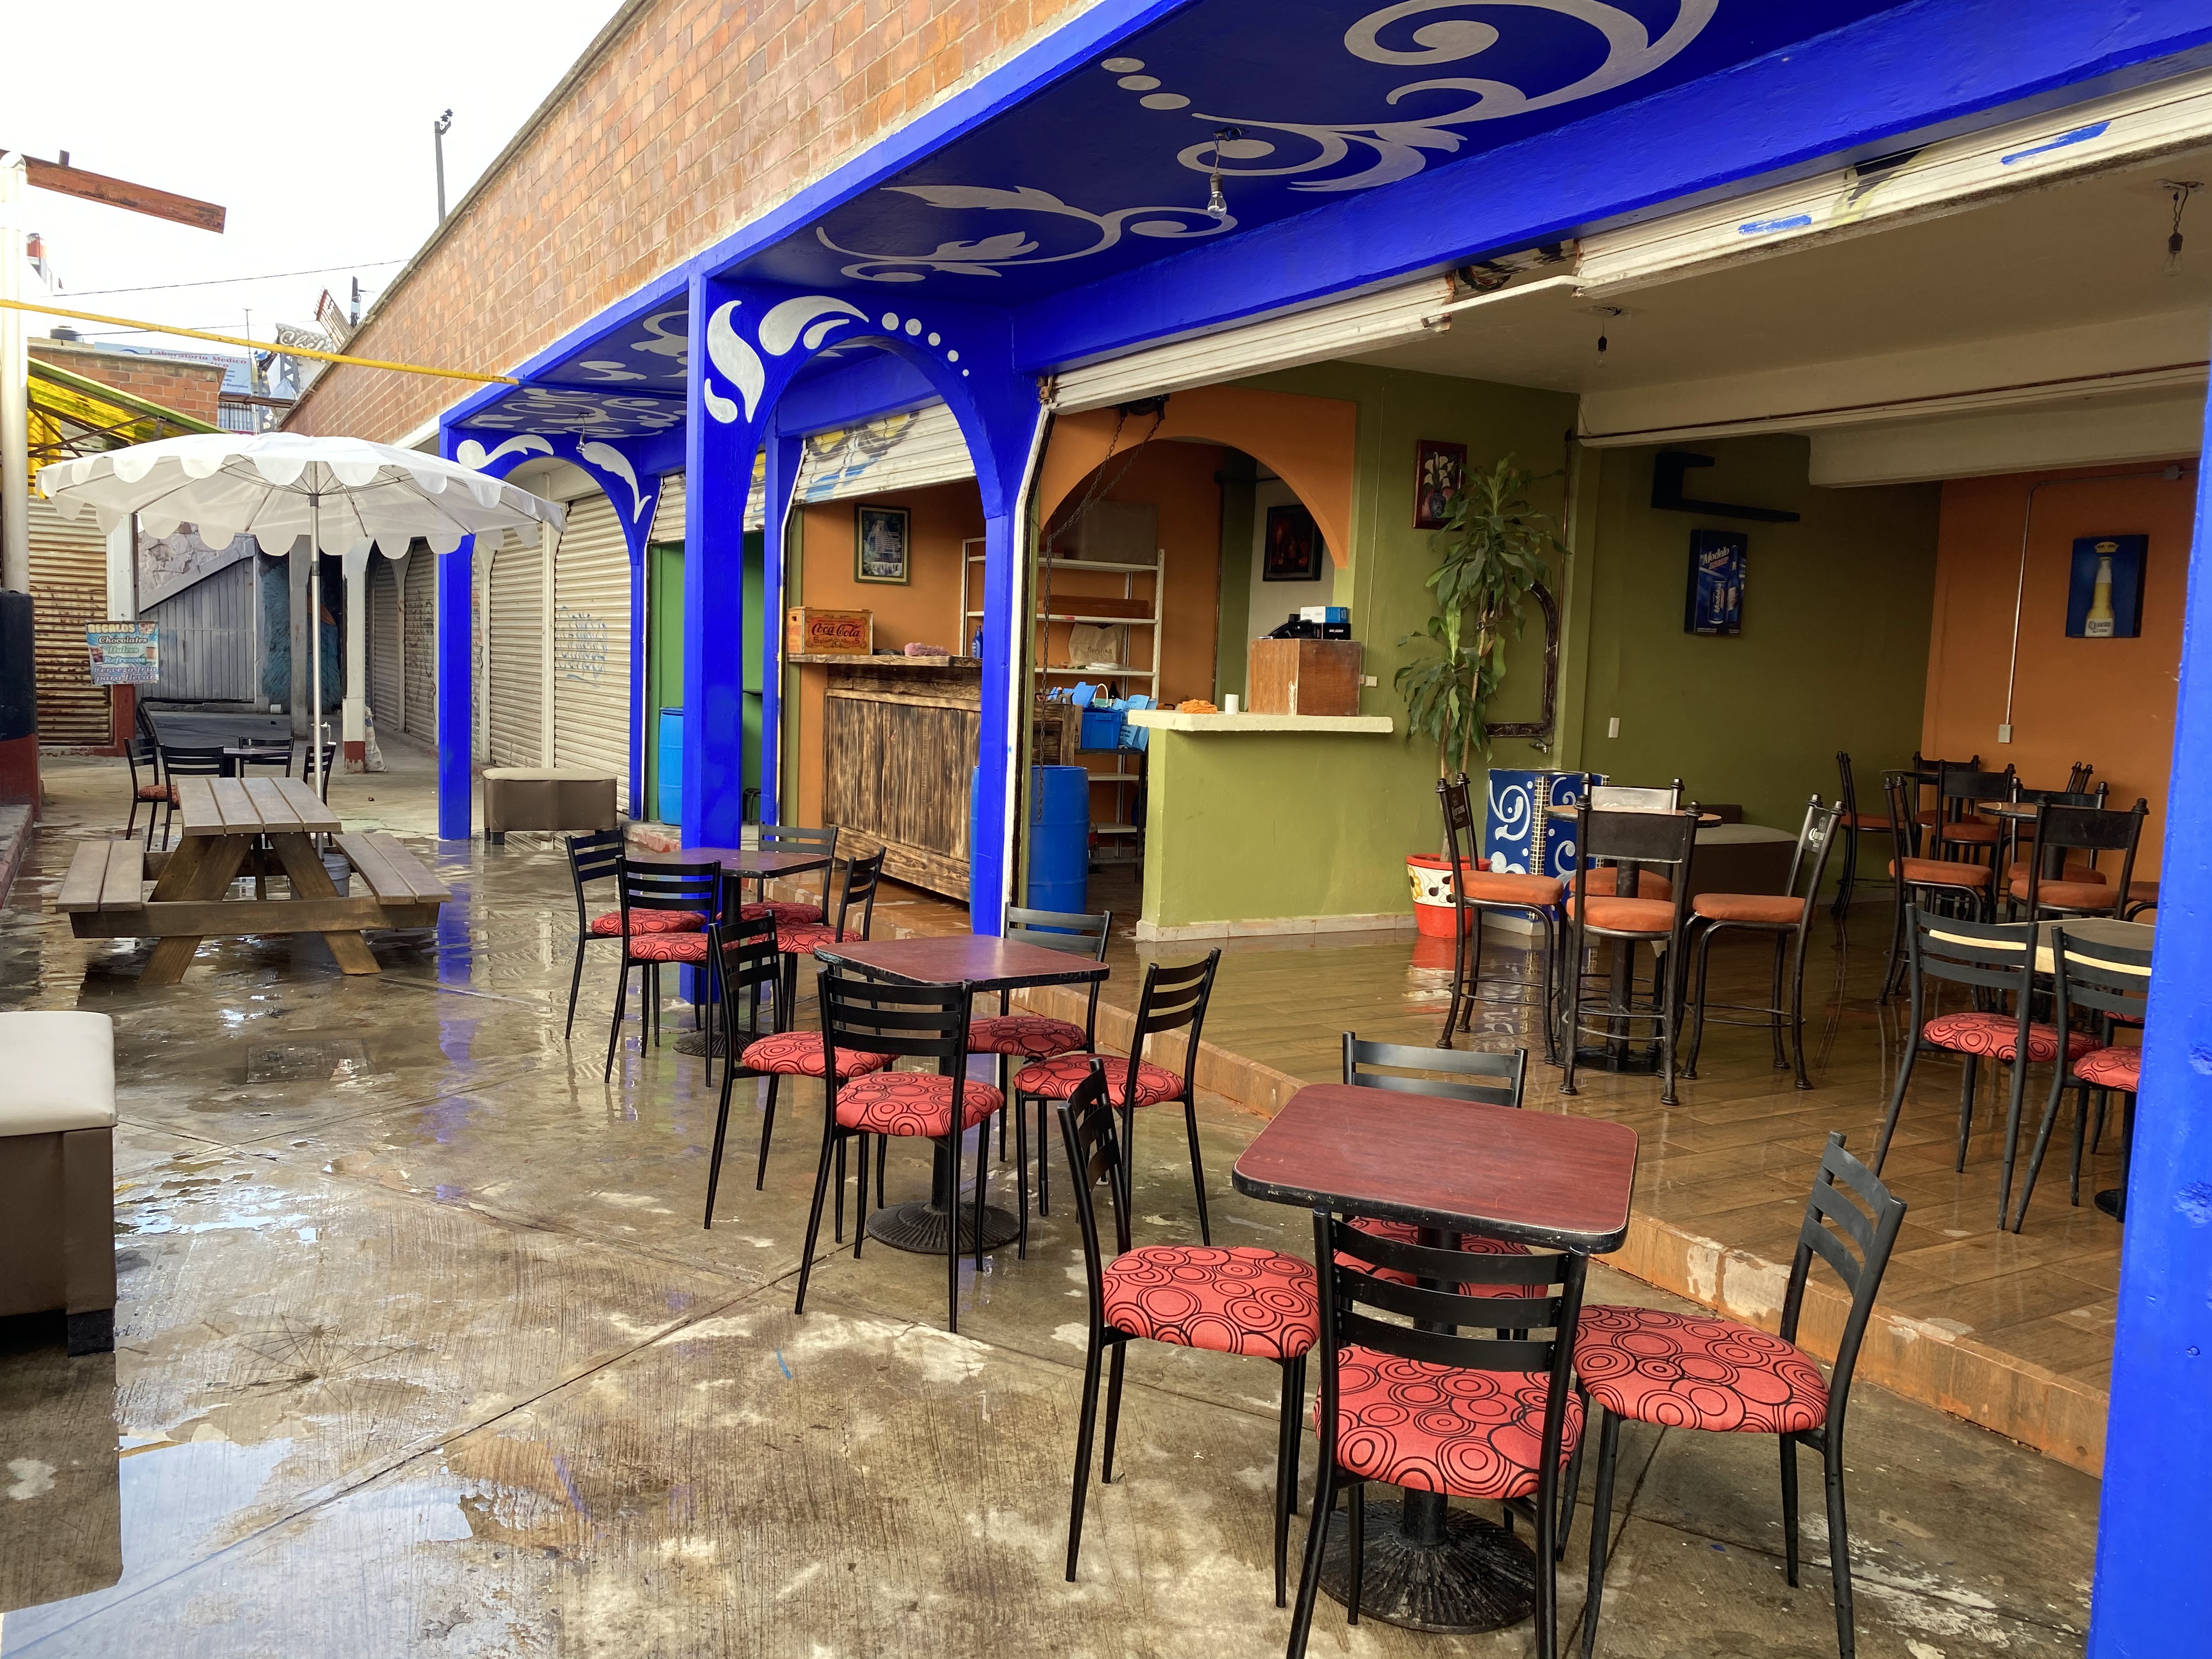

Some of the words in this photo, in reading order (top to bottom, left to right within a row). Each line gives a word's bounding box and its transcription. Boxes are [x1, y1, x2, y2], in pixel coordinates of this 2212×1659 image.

[149, 349, 208, 360] Laboratorio
[1702, 546, 1730, 565] Modelo
[87, 623, 136, 634] REGALOS
[104, 656, 146, 665] Refrescos
